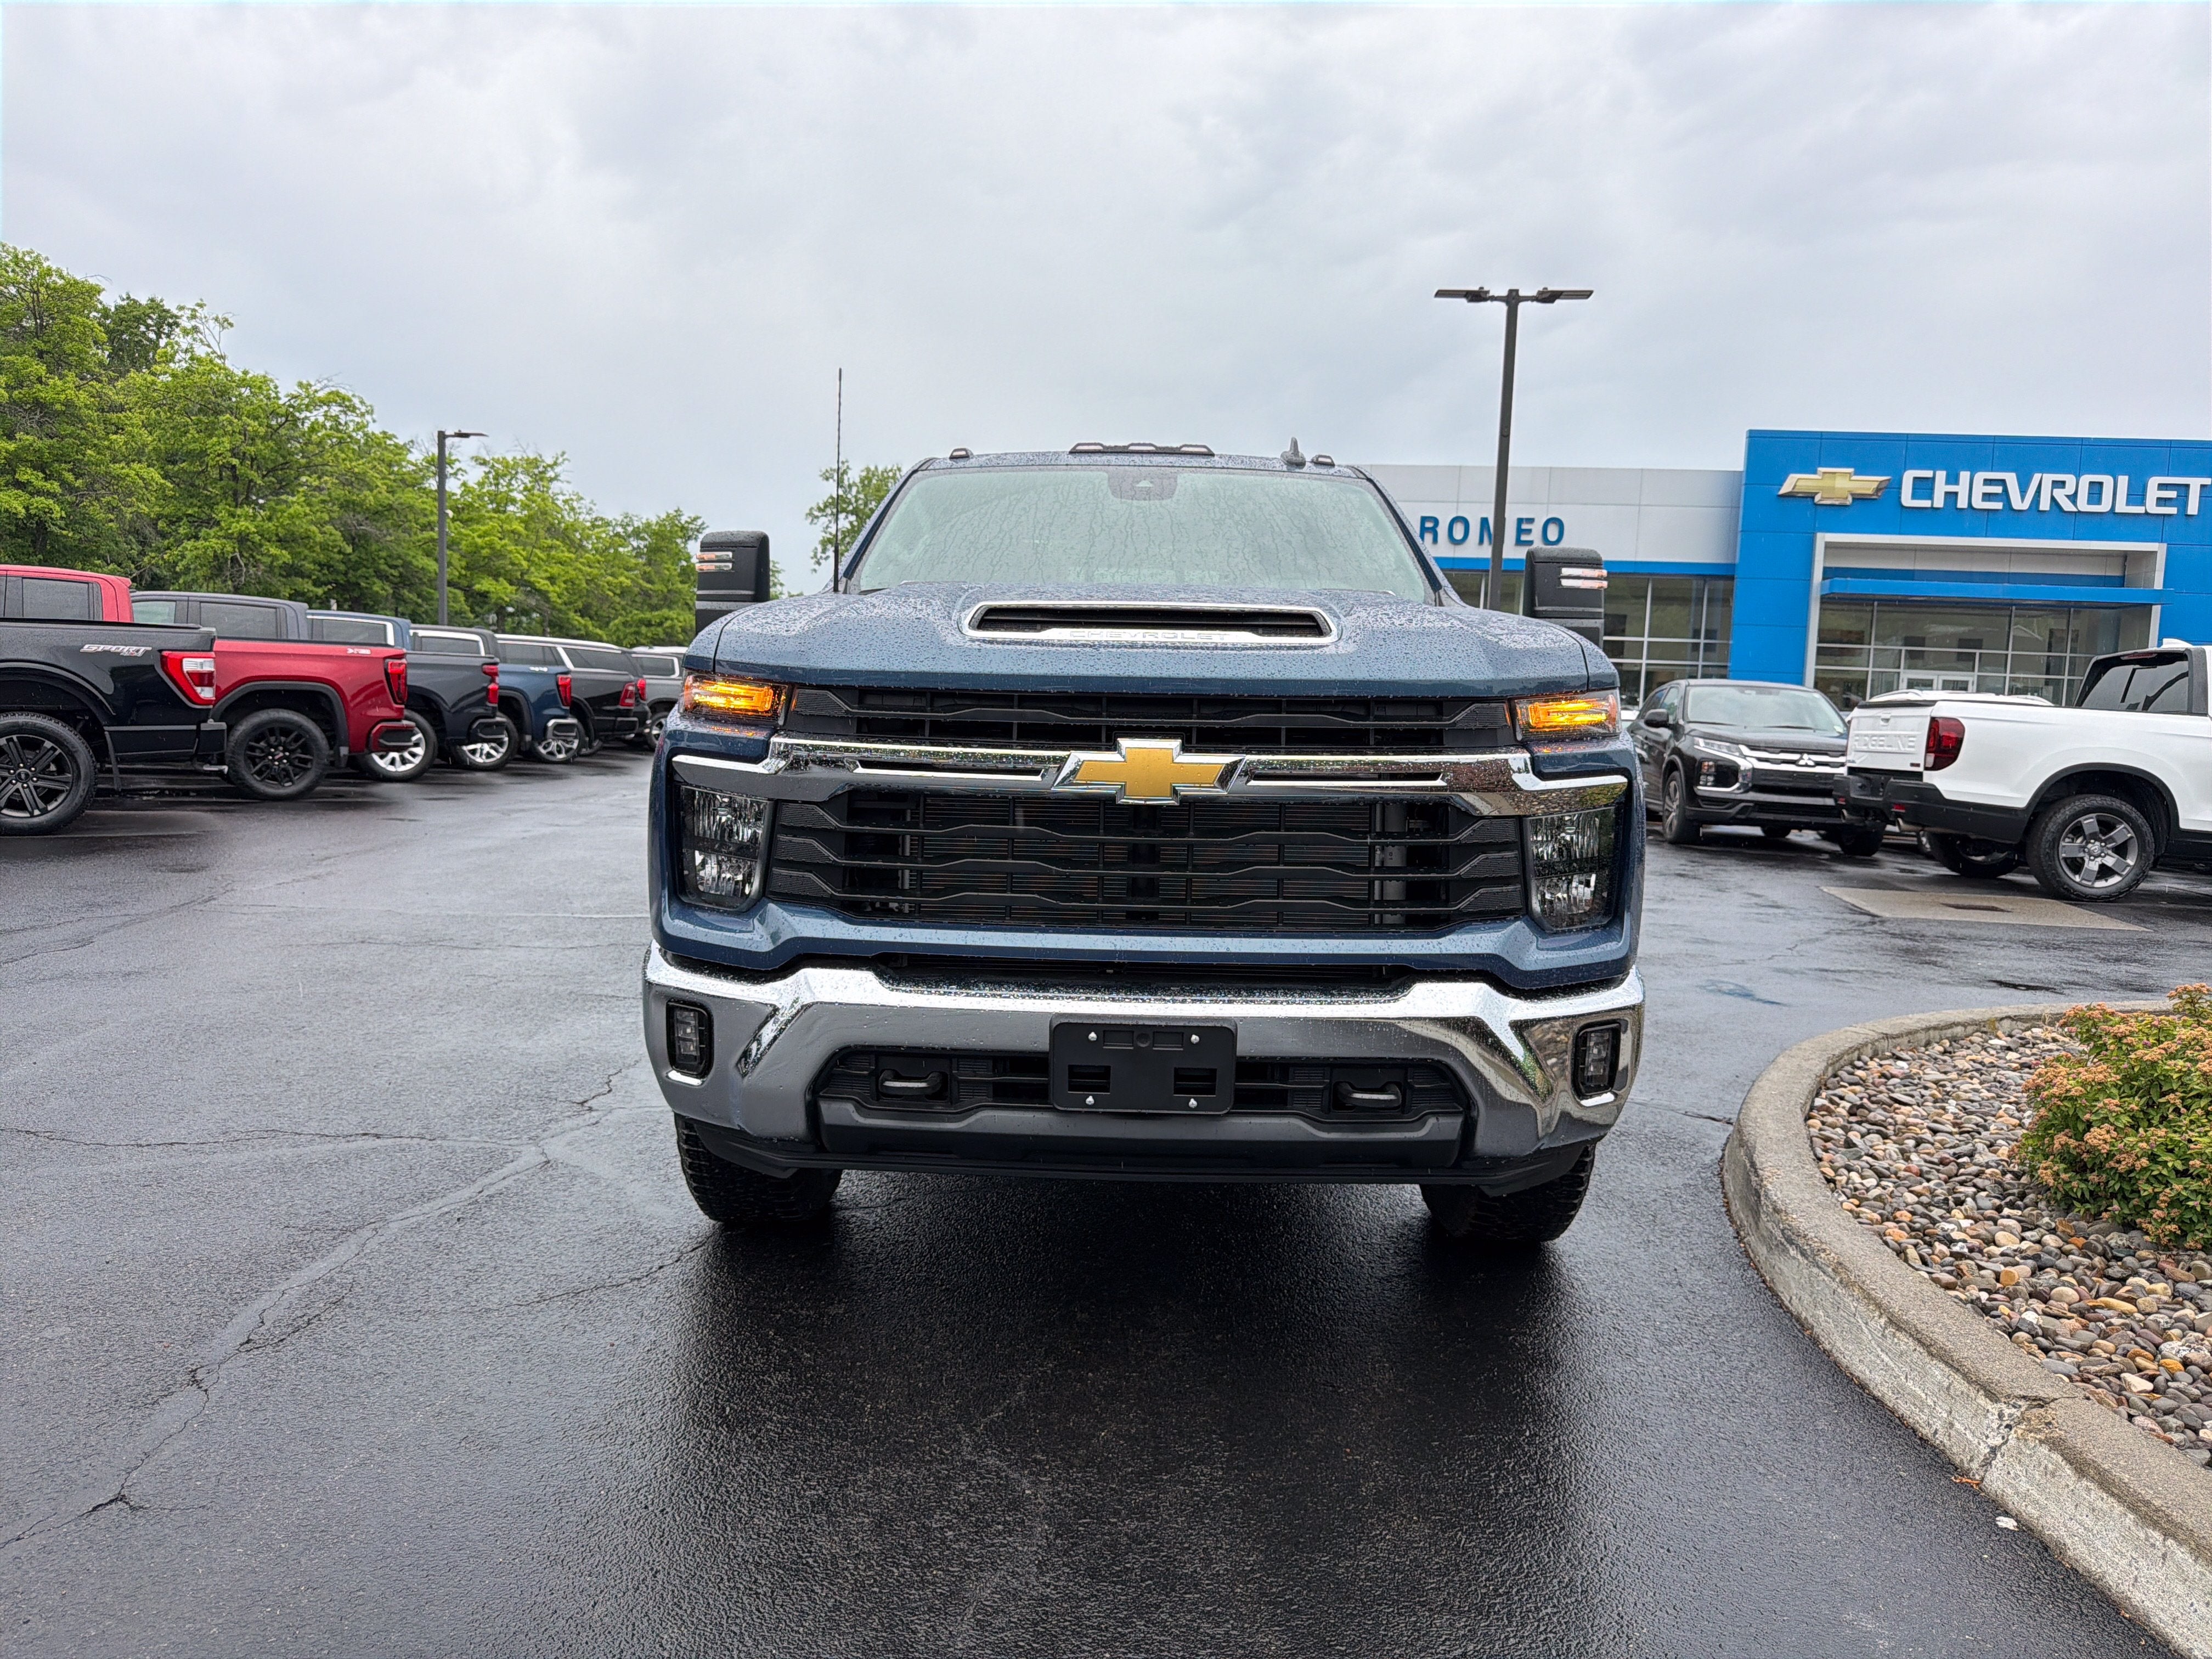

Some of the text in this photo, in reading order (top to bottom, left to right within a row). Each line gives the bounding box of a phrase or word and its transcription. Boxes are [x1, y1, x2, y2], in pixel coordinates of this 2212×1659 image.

[1901, 470, 2211, 515] CHEVROLET
[1070, 630, 1229, 640] CHEVROLET
[80, 644, 153, 657] SPORT
